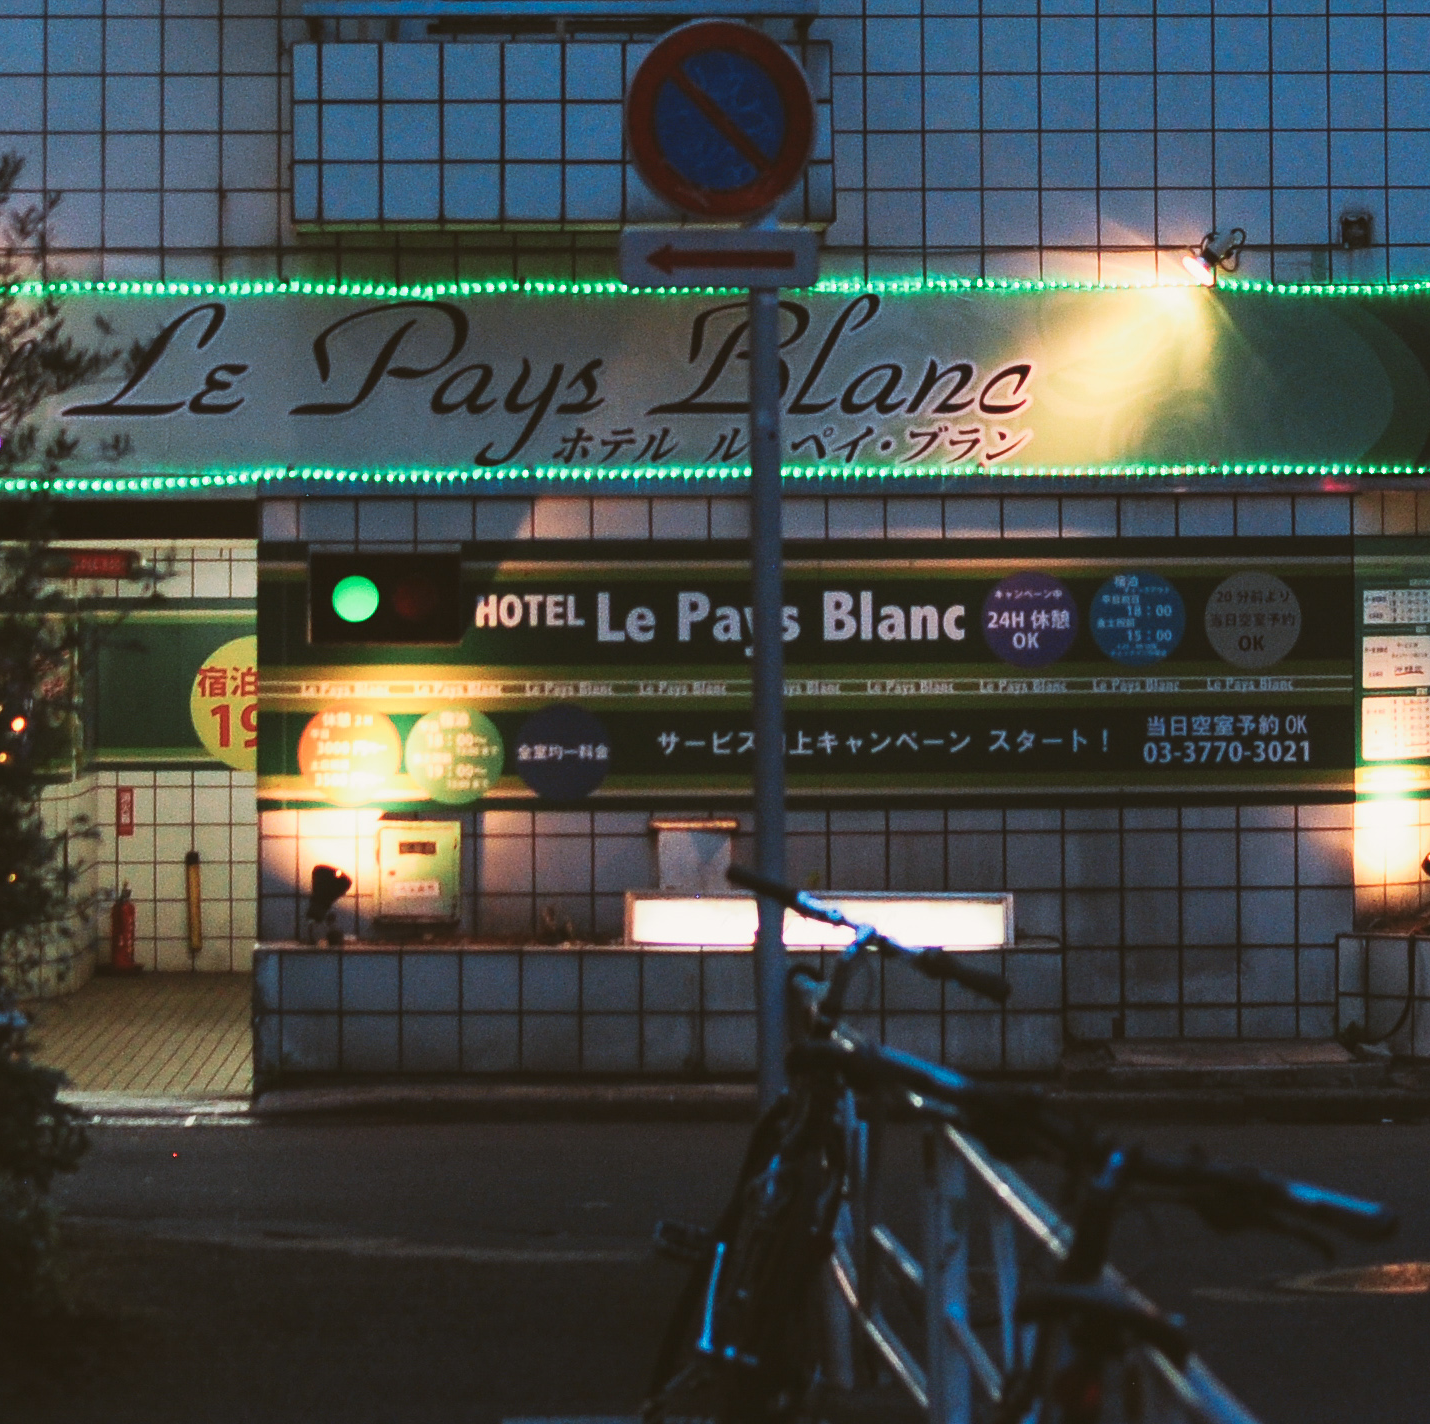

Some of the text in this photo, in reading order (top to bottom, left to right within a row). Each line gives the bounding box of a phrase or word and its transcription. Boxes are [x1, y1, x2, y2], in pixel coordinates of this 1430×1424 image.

[62, 294, 1032, 467] Le Pays Blanc
[553, 426, 1033, 464] ホテル ルペイ・ブラン
[475, 593, 586, 628] HOTEL
[597, 591, 656, 642] Le
[823, 590, 967, 642] Blanc
[987, 609, 1070, 629] 24H 休憩
[1012, 632, 1039, 649] OK
[1238, 635, 1265, 652] OK
[198, 666, 257, 697] 宿泊
[1147, 715, 1307, 736] 当日空室予約 OK
[657, 730, 970, 756] サービス上キャンペーン
[1143, 740, 1310, 763] 03-3770-3021
